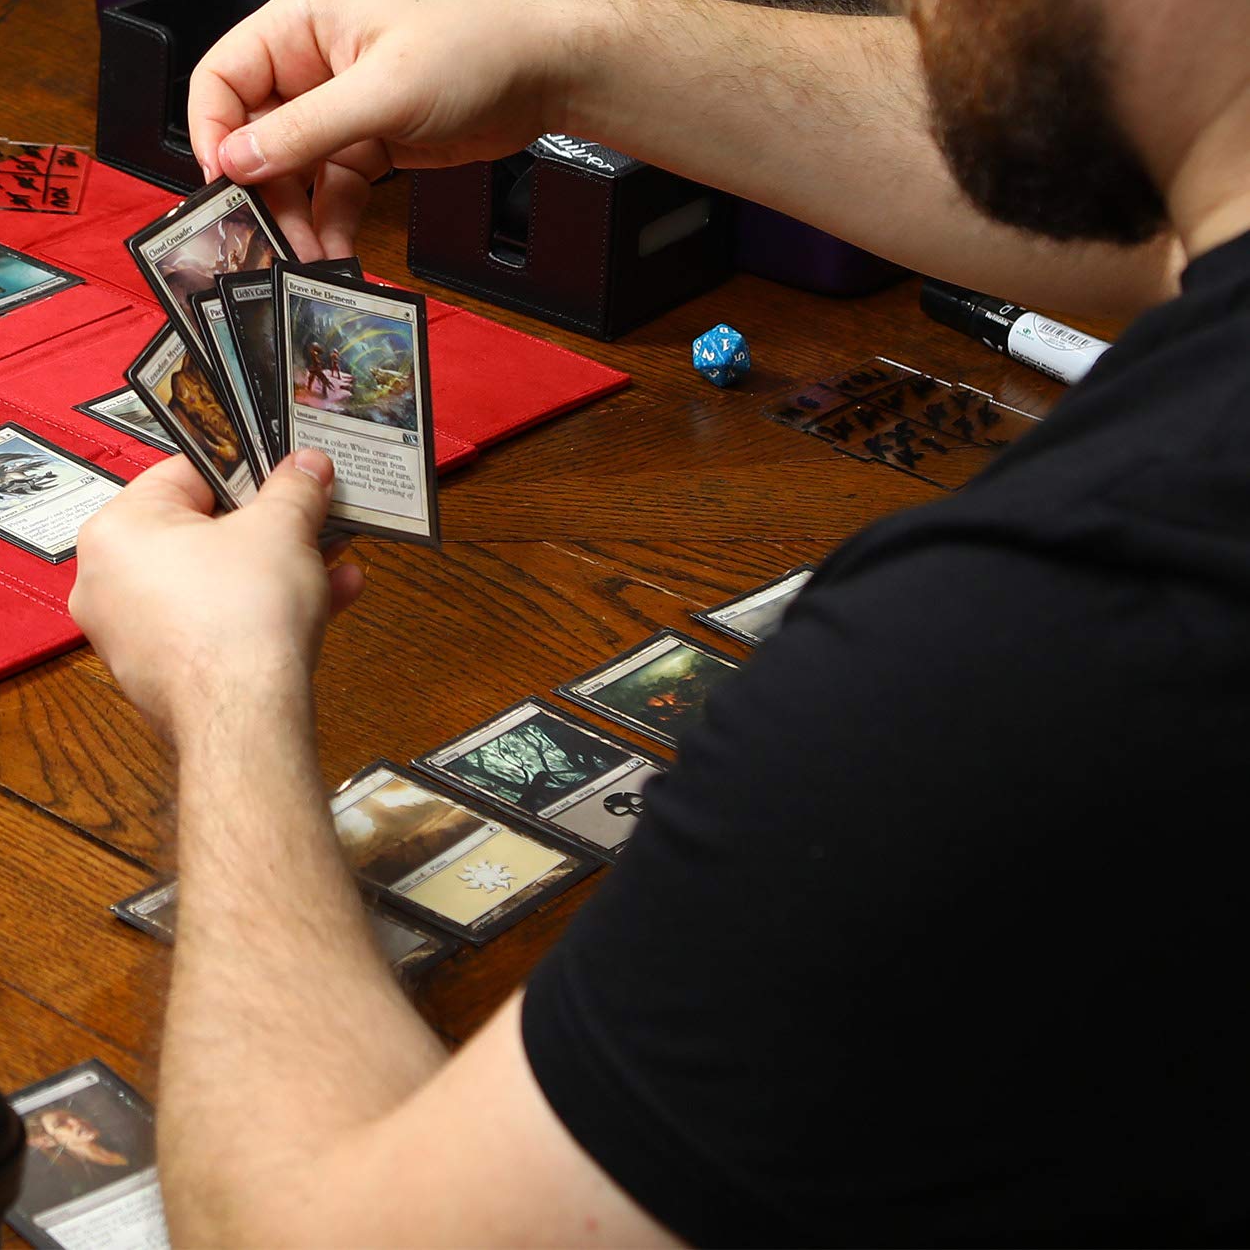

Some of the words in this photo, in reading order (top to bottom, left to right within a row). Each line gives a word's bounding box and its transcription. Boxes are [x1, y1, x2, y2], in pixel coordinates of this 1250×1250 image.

[148, 242, 168, 258] Cloud
[166, 224, 194, 248] Crusader
[290, 281, 310, 294] Brave
[310, 287, 322, 297] the
[323, 290, 357, 306] Elements
[298, 431, 323, 443] Choose
[350, 443, 370, 454] White
[372, 449, 403, 462] creatures
[338, 450, 353, 461] gain
[353, 453, 388, 468] protection
[389, 460, 407, 471] from
[355, 462, 371, 473] until
[372, 465, 385, 476] end
